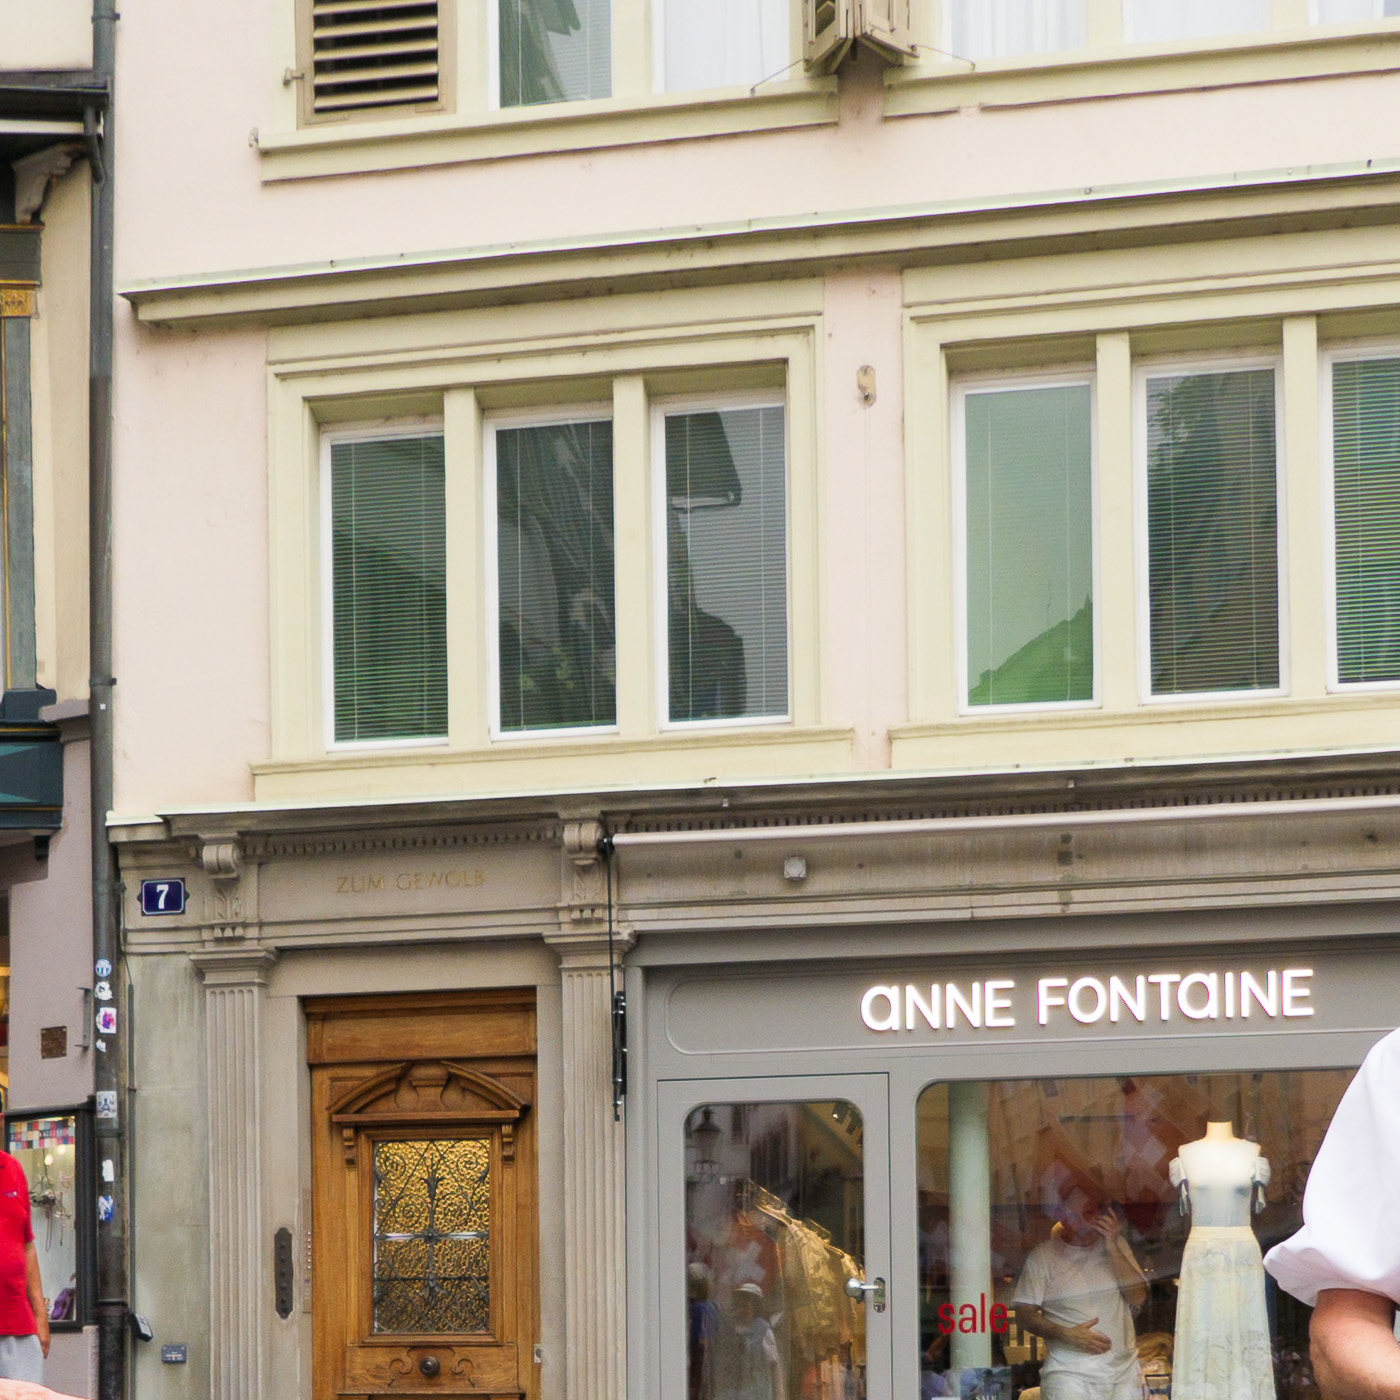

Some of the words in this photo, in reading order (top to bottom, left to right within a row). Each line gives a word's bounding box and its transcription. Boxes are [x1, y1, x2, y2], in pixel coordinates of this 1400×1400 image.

[336, 874, 385, 893] ZUM
[156, 884, 169, 910] 7
[938, 1292, 1008, 1334] sale
